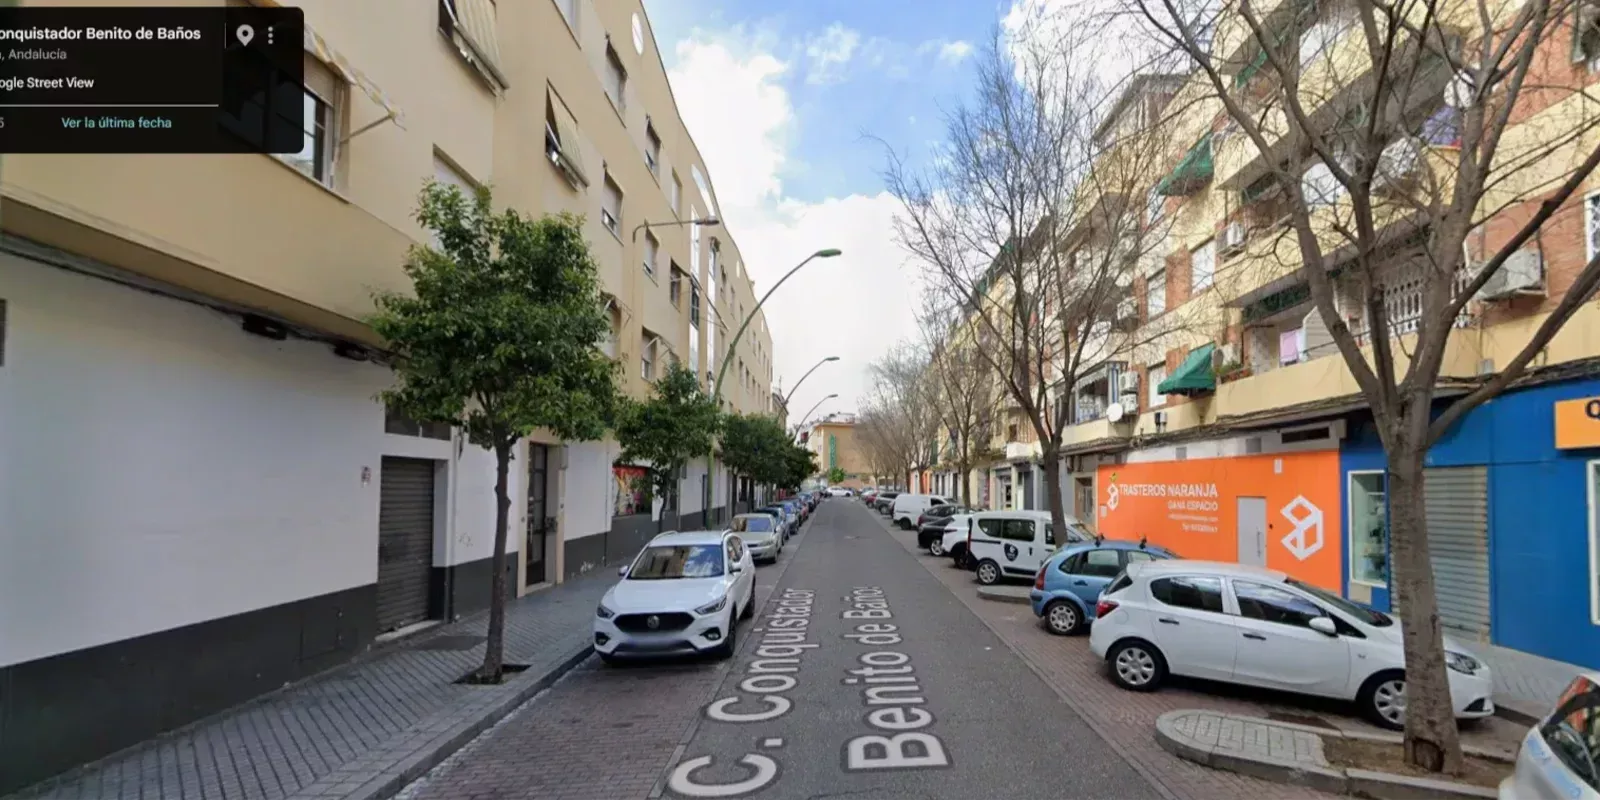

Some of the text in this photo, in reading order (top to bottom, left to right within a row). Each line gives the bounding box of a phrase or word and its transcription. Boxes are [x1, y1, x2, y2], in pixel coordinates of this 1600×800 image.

[1119, 483, 1218, 498] TRASTEROS NARANJA
[1167, 500, 1218, 511] GANA ESPACIO
